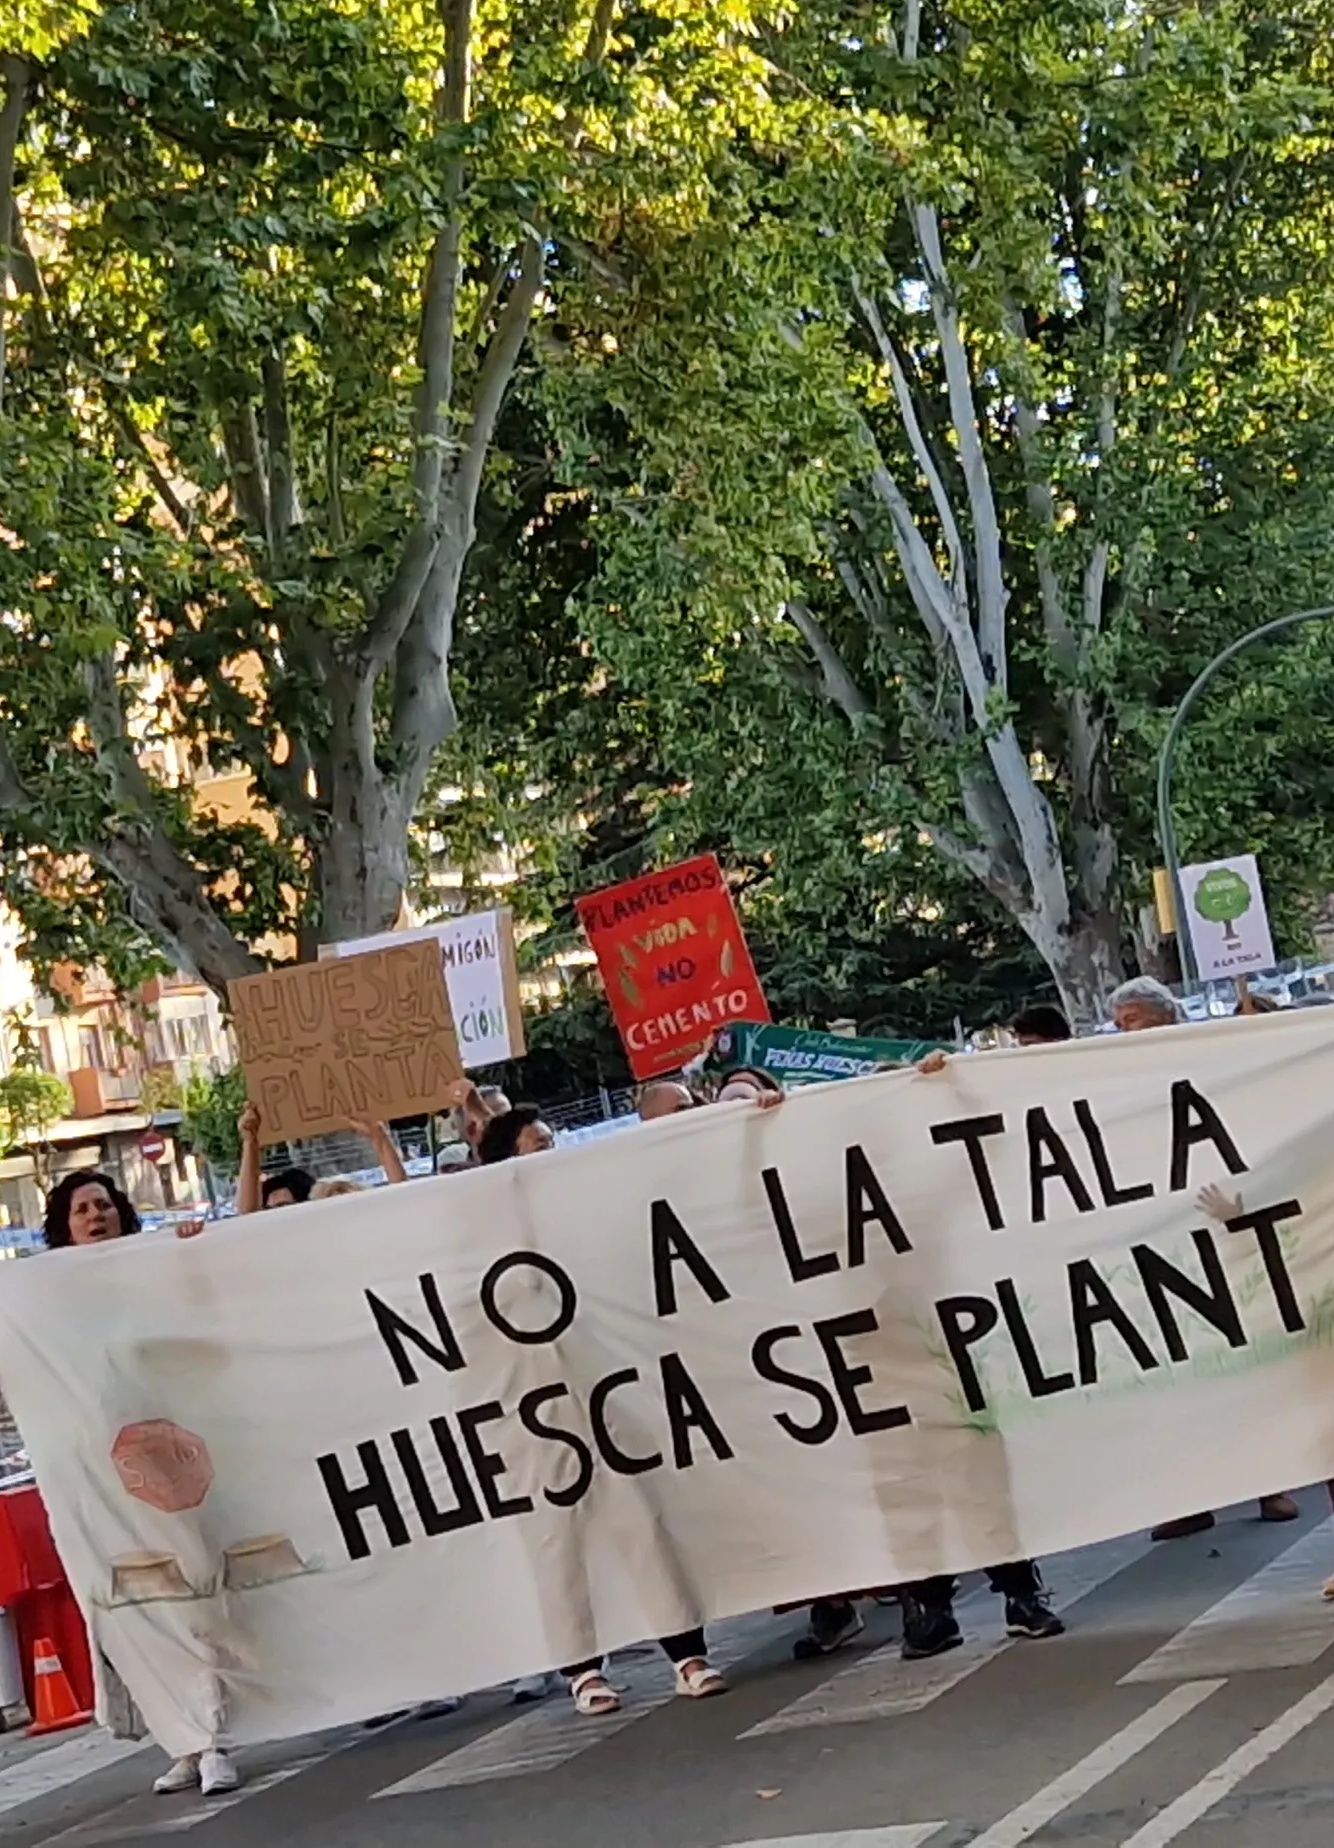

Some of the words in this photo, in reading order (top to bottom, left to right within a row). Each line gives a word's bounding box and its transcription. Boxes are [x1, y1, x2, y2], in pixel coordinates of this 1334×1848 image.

[581, 865, 716, 932] PLANTEMOS
[633, 916, 699, 954] VIDA
[656, 956, 697, 985] NO
[626, 987, 748, 1051] CEMENTO
[260, 1038, 453, 1132] PLANTA
[363, 1251, 577, 1386] NO
[650, 1198, 731, 1317] A
[761, 1144, 913, 1283] LA
[929, 1079, 1249, 1231] TALA
[316, 1352, 735, 1560] HUESCA
[751, 1308, 912, 1445] SE
